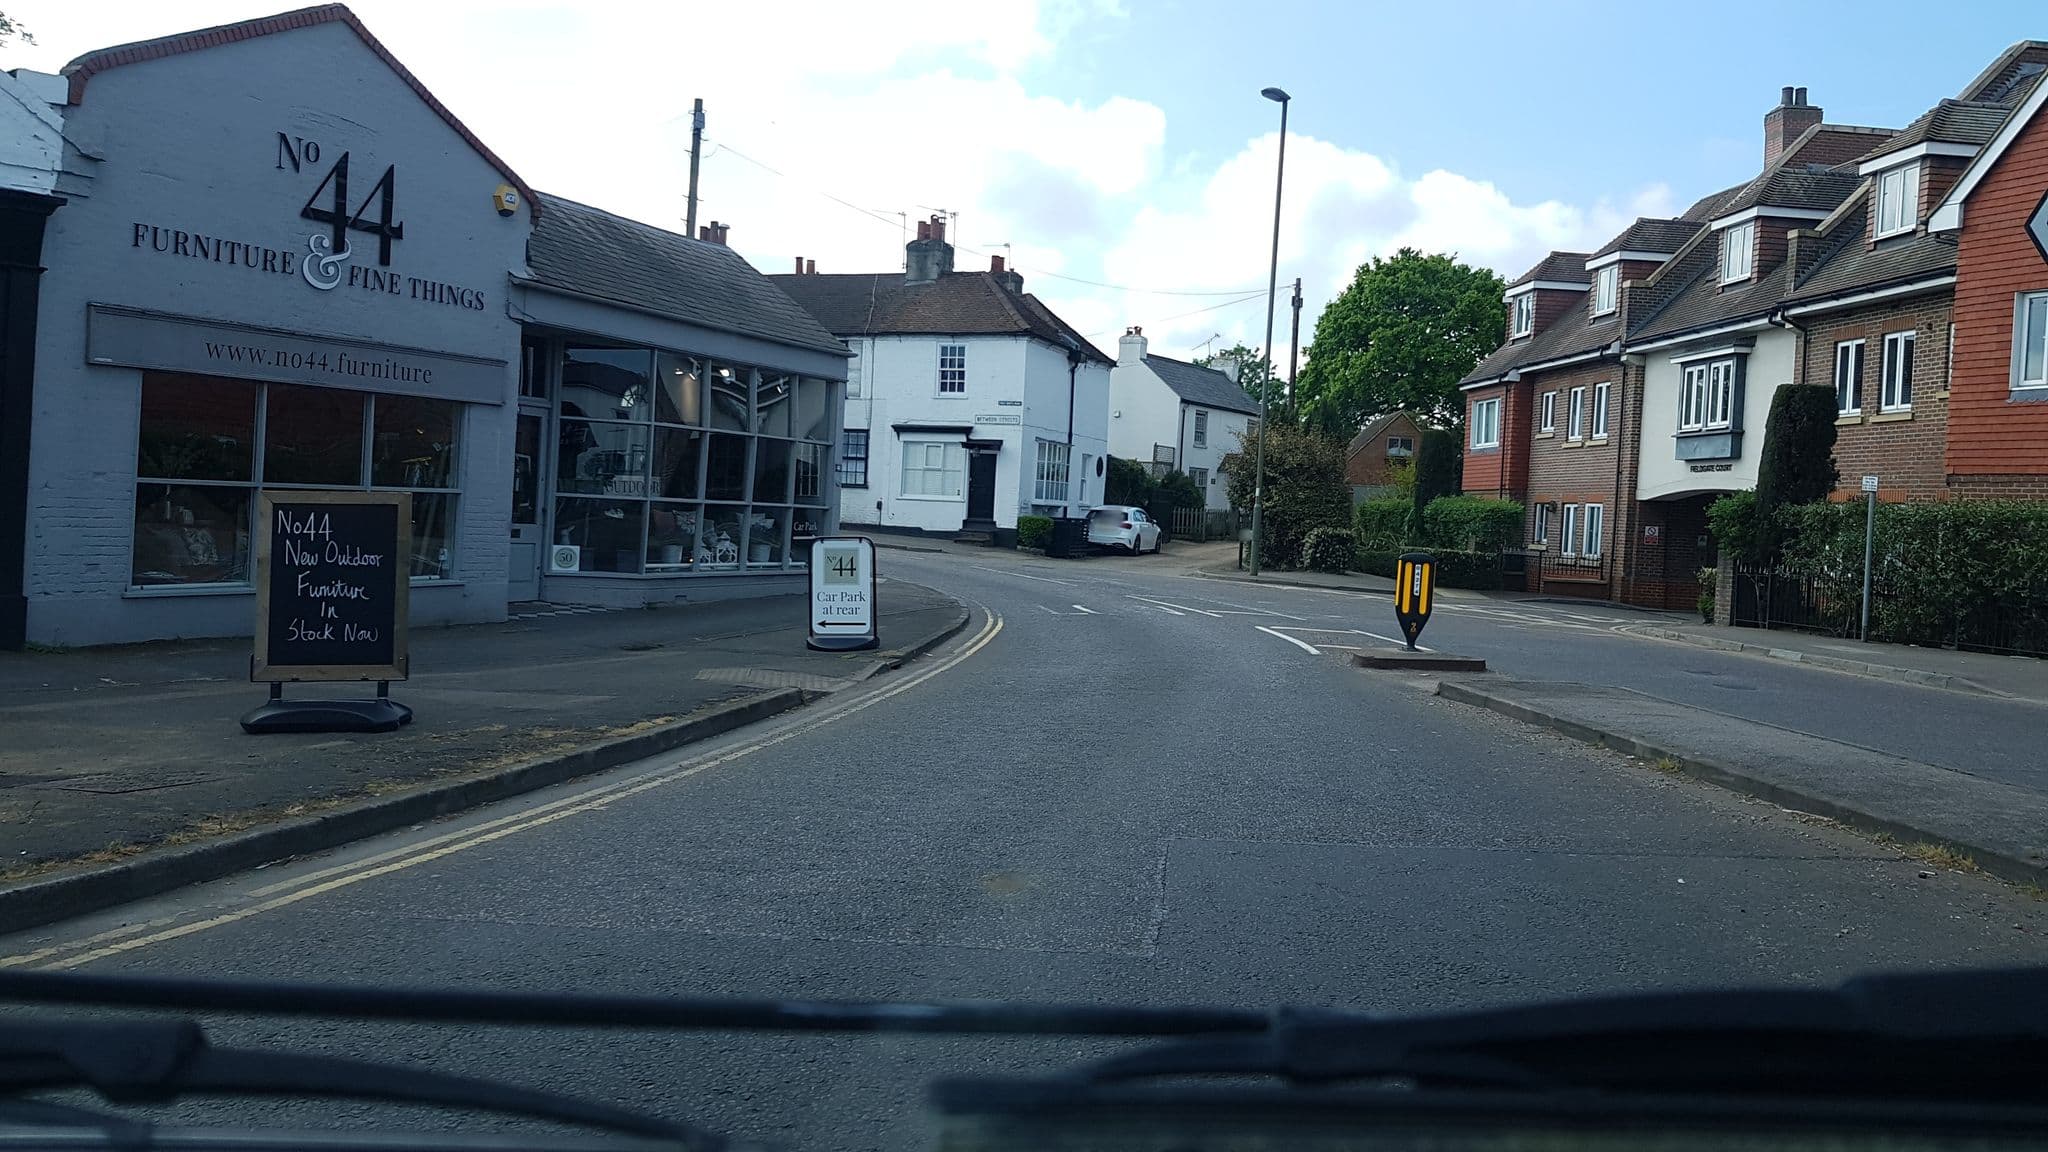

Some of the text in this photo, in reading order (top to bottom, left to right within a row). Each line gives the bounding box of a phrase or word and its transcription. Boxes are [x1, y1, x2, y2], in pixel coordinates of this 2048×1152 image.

[276, 131, 404, 266] No 44
[131, 222, 485, 311] FURNITURE & FINE THINGS
[205, 342, 433, 384] www.no44.furniture
[278, 509, 333, 541] No44
[793, 521, 817, 531] Car Park
[285, 539, 383, 567] New Outdoor
[832, 556, 857, 577] 44
[297, 570, 370, 600] Furniture
[817, 591, 866, 602] Car Park
[321, 601, 339, 618] In
[822, 604, 861, 615] at rear
[287, 618, 379, 642] Stock Now
